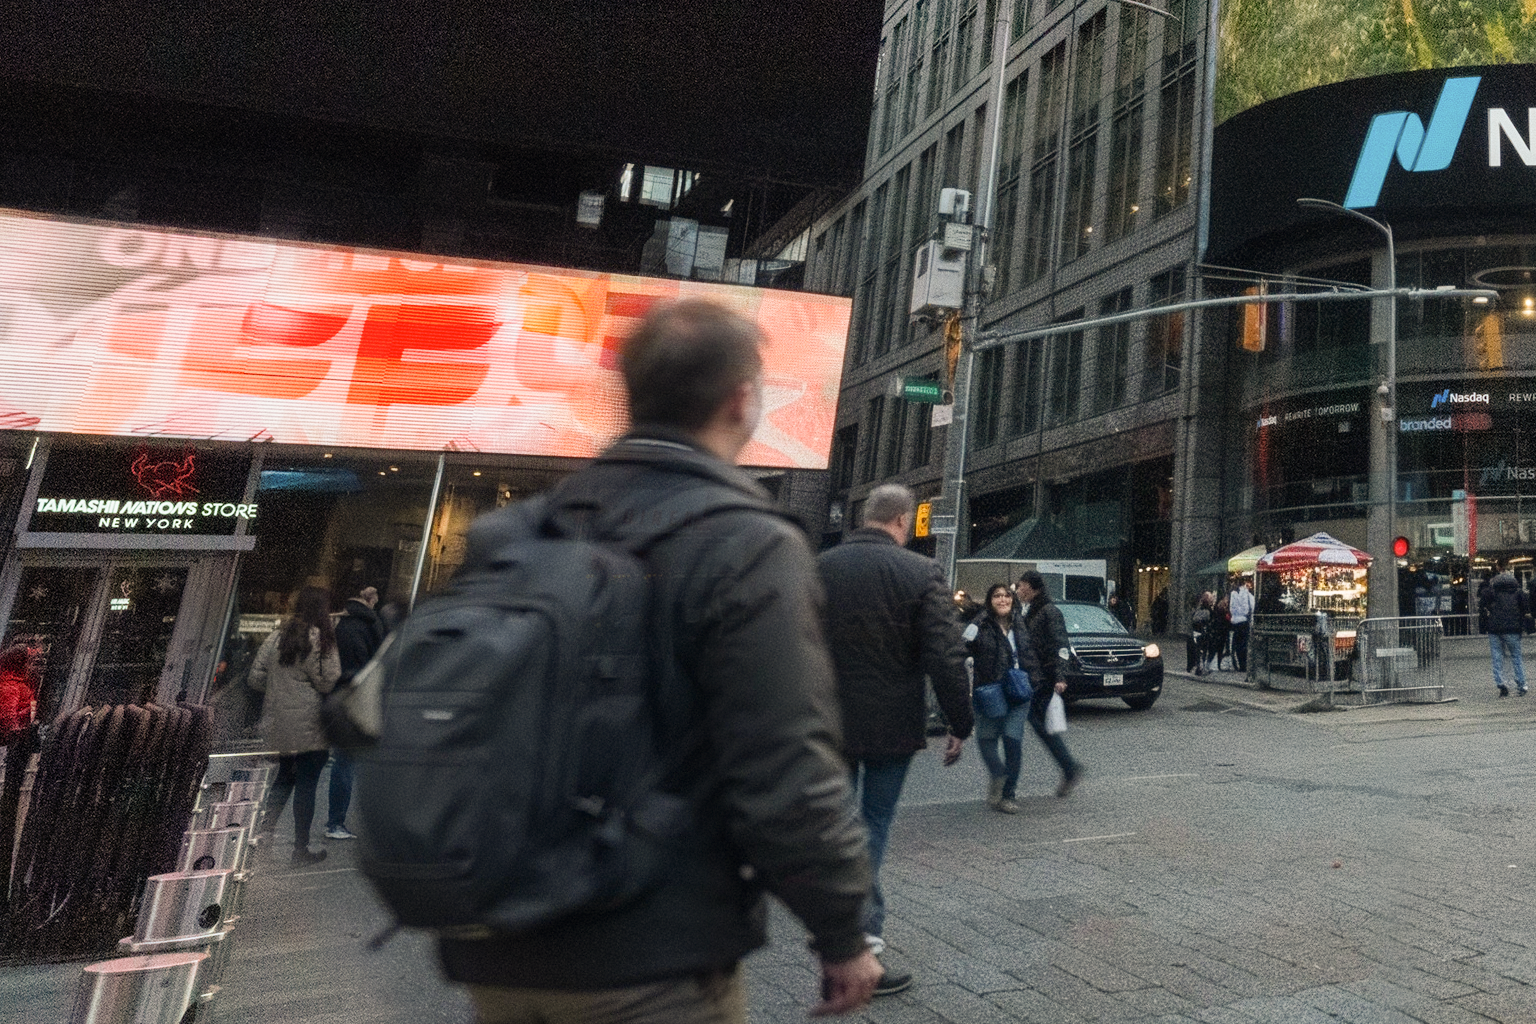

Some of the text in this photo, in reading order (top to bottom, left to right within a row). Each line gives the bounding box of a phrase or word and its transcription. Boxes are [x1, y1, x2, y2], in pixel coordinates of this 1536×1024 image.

[1449, 391, 1489, 404] Nasdaq
[1400, 415, 1452, 431] branded
[37, 498, 259, 520] TAMASHII NATIONS STORE
[98, 517, 194, 529] NEW YORK
